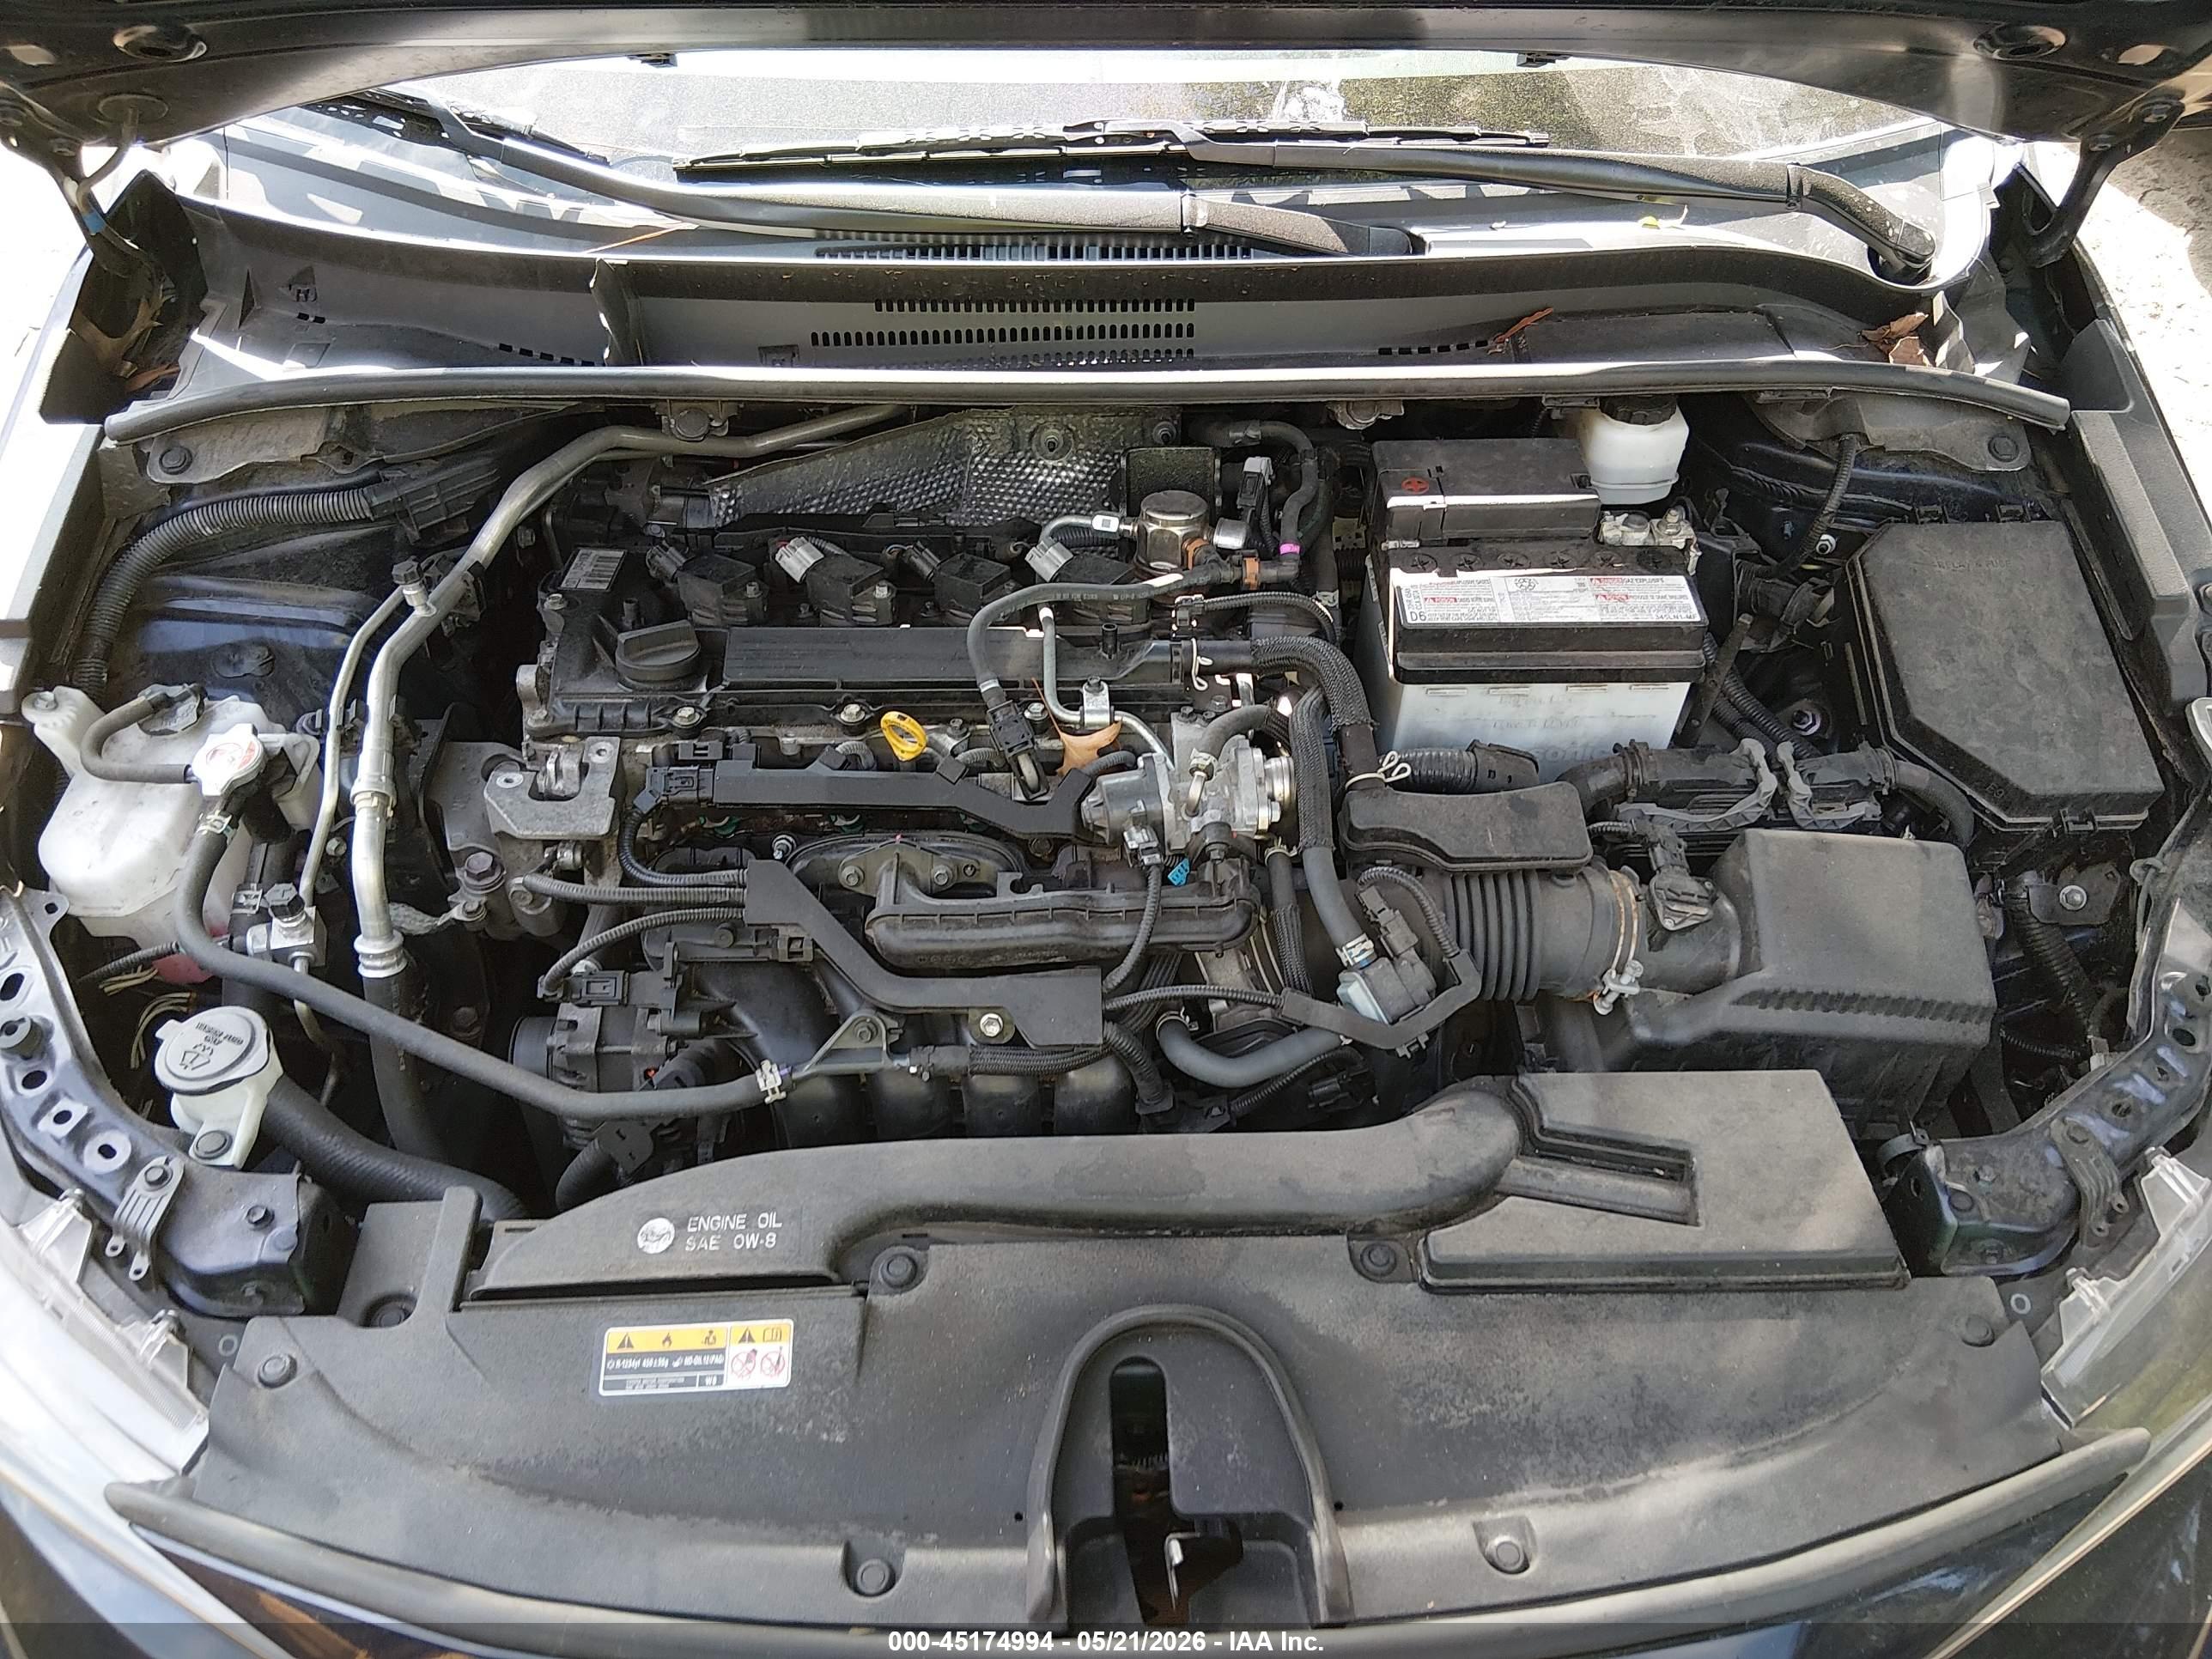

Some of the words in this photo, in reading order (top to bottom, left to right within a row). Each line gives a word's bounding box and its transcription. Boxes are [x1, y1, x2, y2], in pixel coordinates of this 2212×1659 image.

[1410, 611, 1427, 622] D6
[687, 1213, 748, 1233] ENGINE
[757, 1212, 783, 1229] OIL
[685, 1234, 722, 1252] SAE
